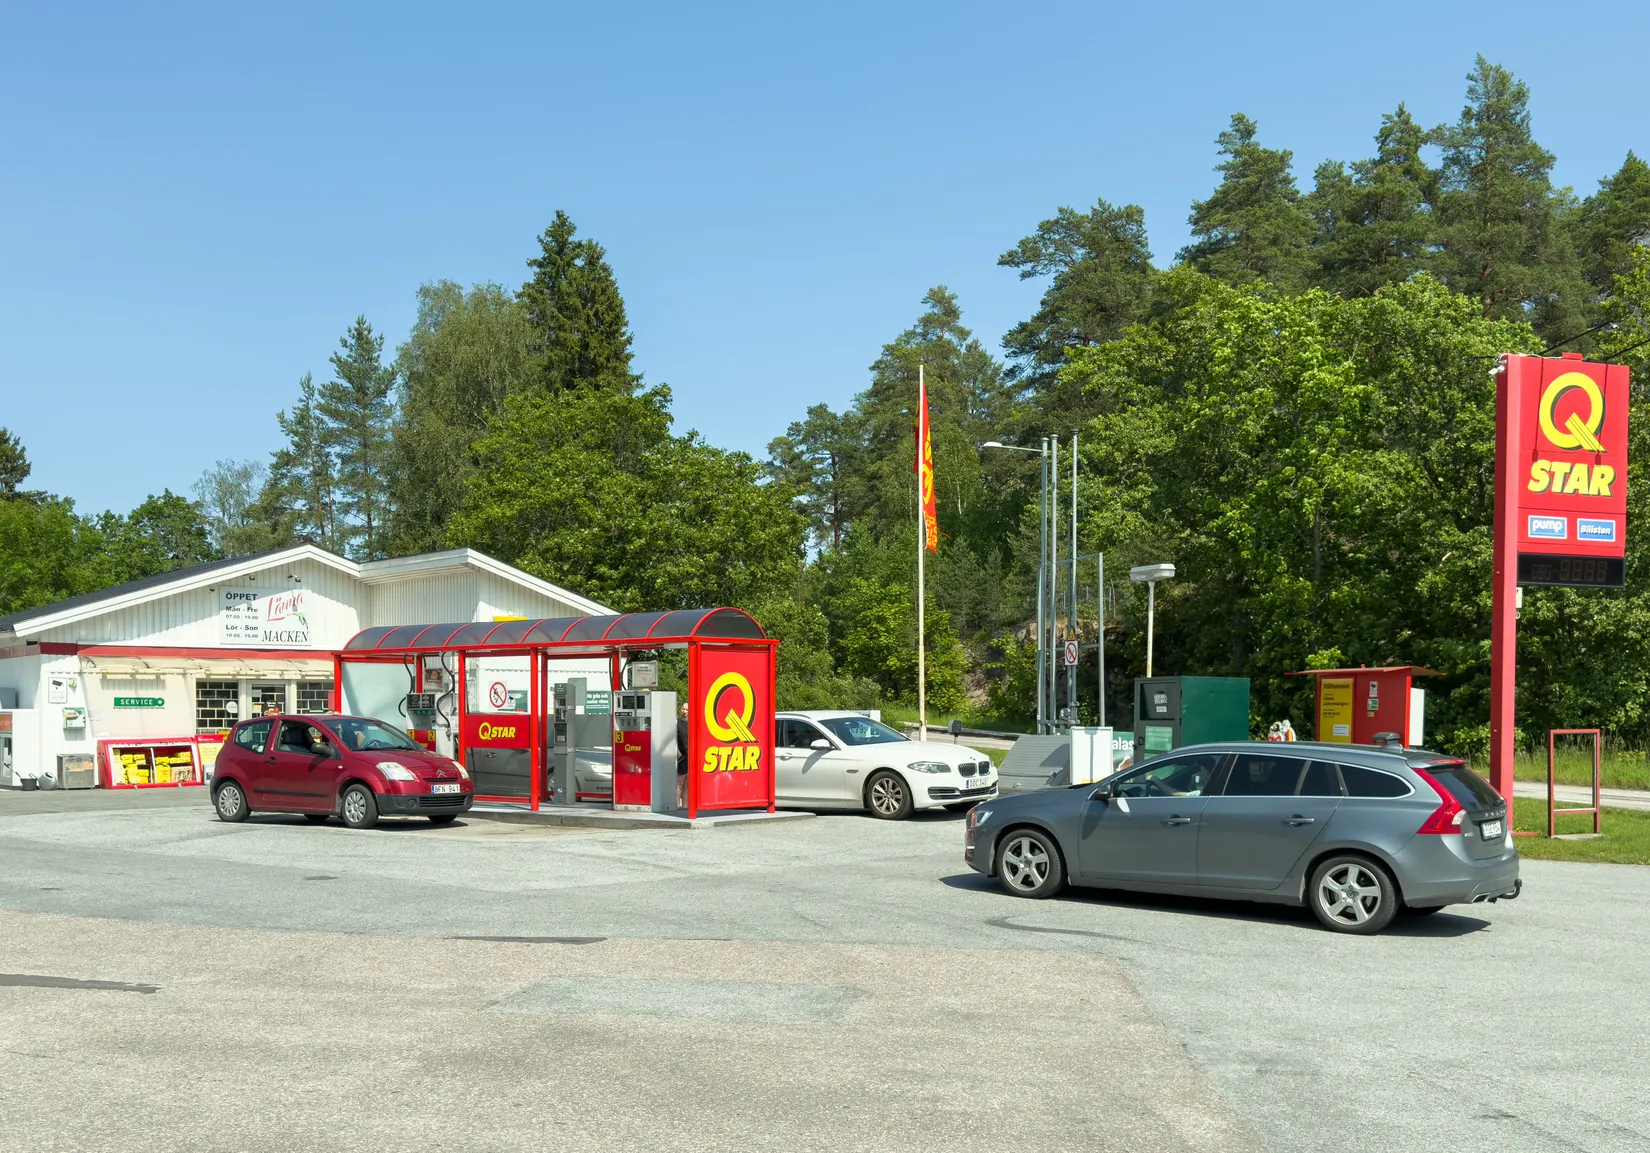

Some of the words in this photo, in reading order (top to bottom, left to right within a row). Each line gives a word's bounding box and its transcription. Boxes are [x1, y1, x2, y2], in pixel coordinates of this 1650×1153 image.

[1539, 372, 1608, 453] Q
[1528, 459, 1616, 497] STAR
[1532, 519, 1563, 533] pump
[1580, 525, 1612, 536] Bilisten
[225, 590, 258, 601] ÖPPET
[262, 630, 309, 643] MACKEN
[120, 698, 154, 706] SERVICE
[704, 671, 759, 743] Q
[616, 732, 623, 742] 3
[703, 746, 761, 773] STAR
